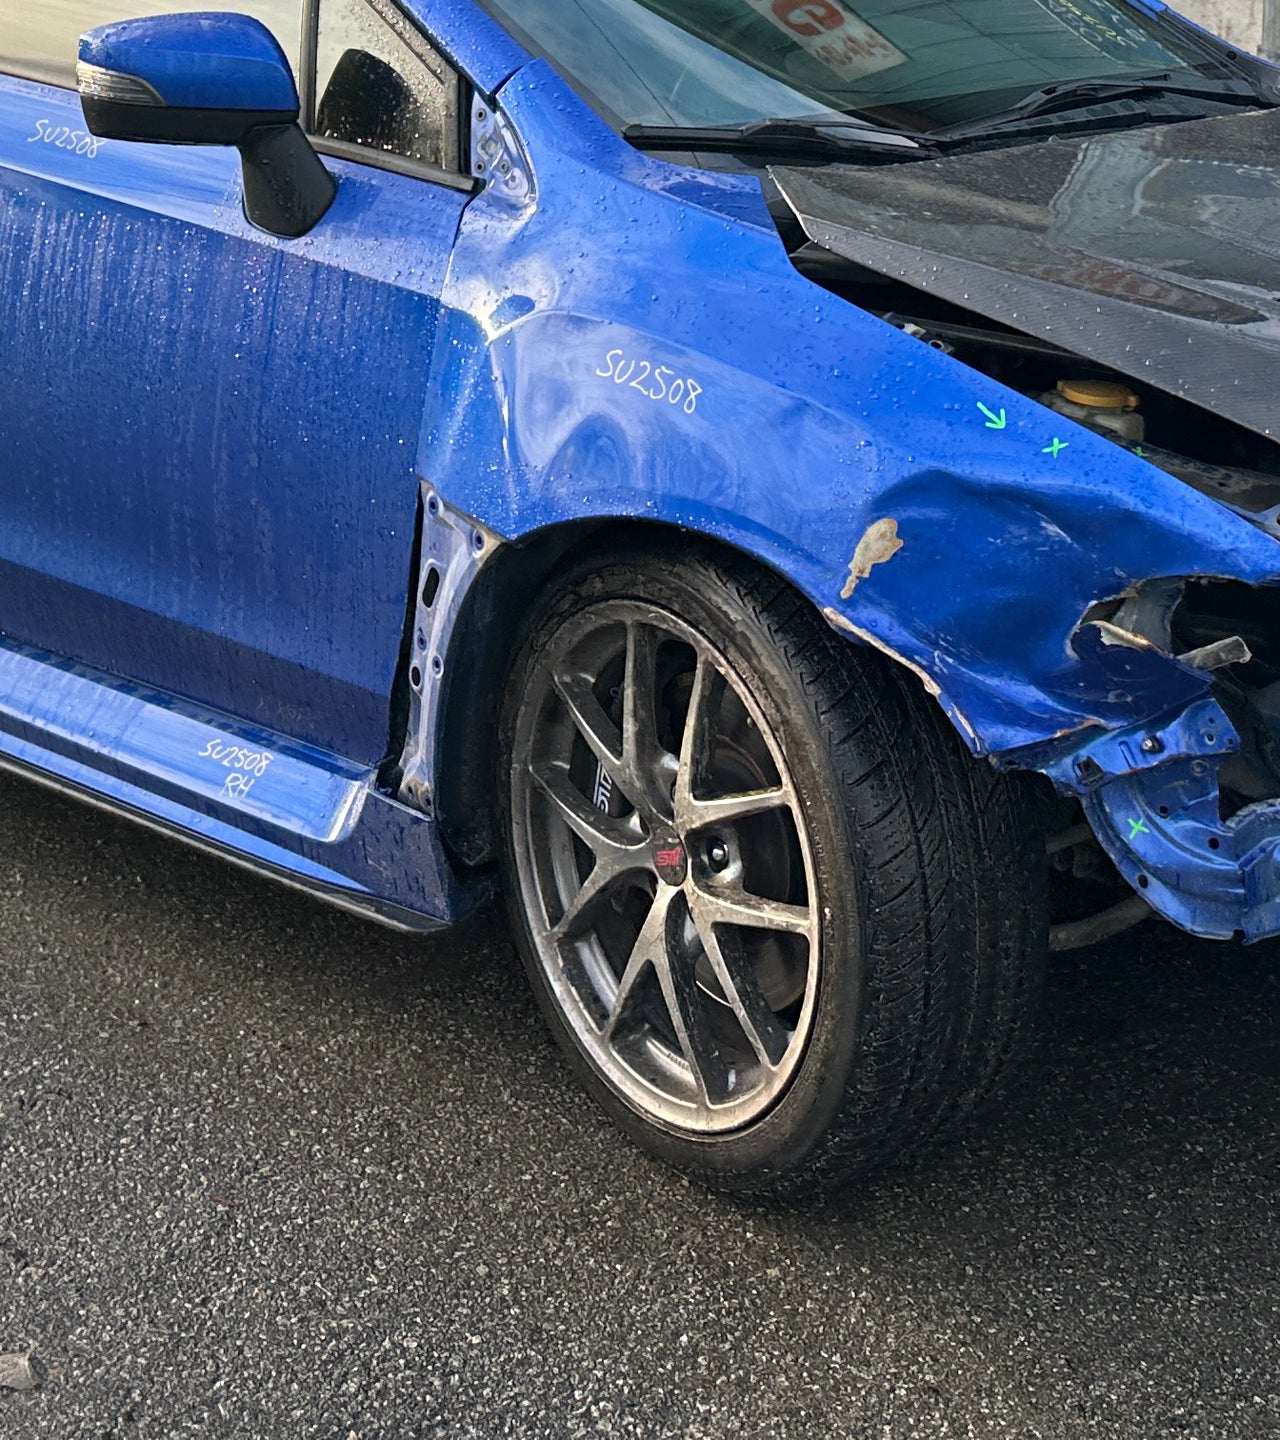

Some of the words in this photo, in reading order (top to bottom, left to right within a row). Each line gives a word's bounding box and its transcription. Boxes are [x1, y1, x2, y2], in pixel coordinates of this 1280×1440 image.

[26, 119, 107, 159] SU2508
[596, 349, 703, 414] SU2508
[197, 738, 275, 777] SU2508
[219, 772, 255, 798] RH
